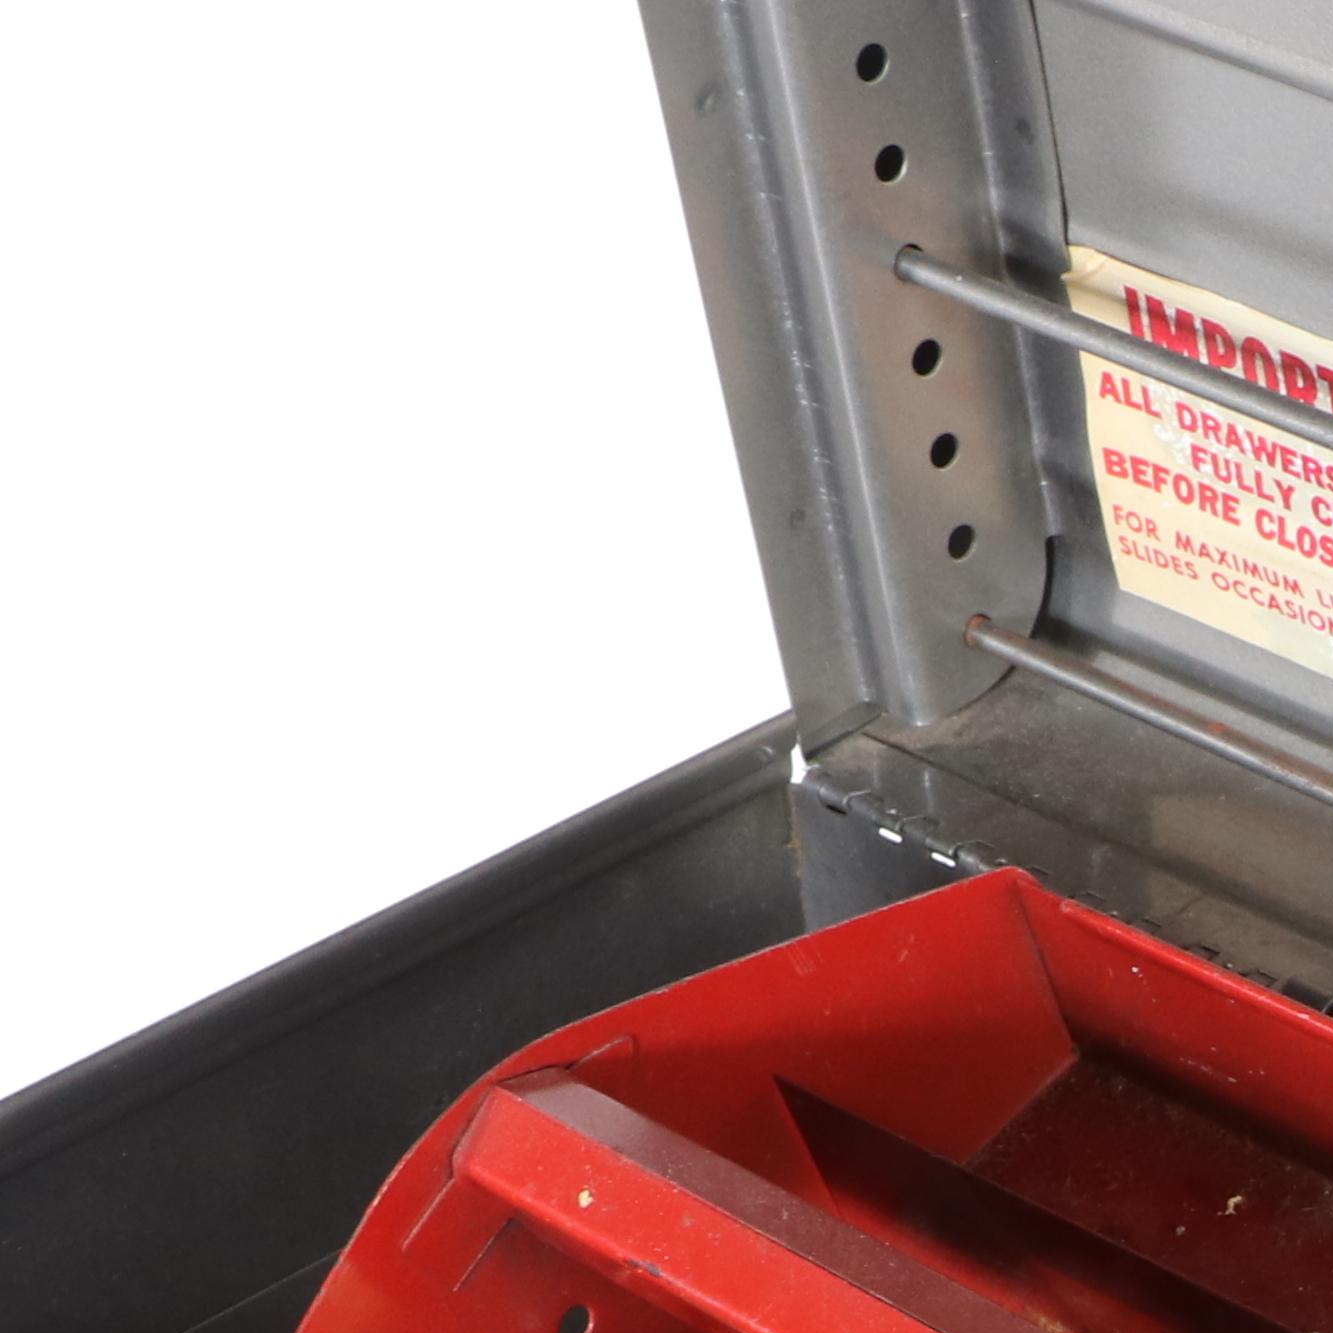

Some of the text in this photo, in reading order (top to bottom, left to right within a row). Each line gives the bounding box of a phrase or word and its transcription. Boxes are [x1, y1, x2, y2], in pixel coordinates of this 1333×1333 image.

[1098, 371, 1162, 419] ALL
[1103, 447, 1241, 524] BEFORE
[1190, 444, 1295, 511] FULLY
[1113, 504, 1159, 541] FOR
[1176, 531, 1302, 597] MAXIMUM
[1119, 536, 1198, 579] SLIDES
